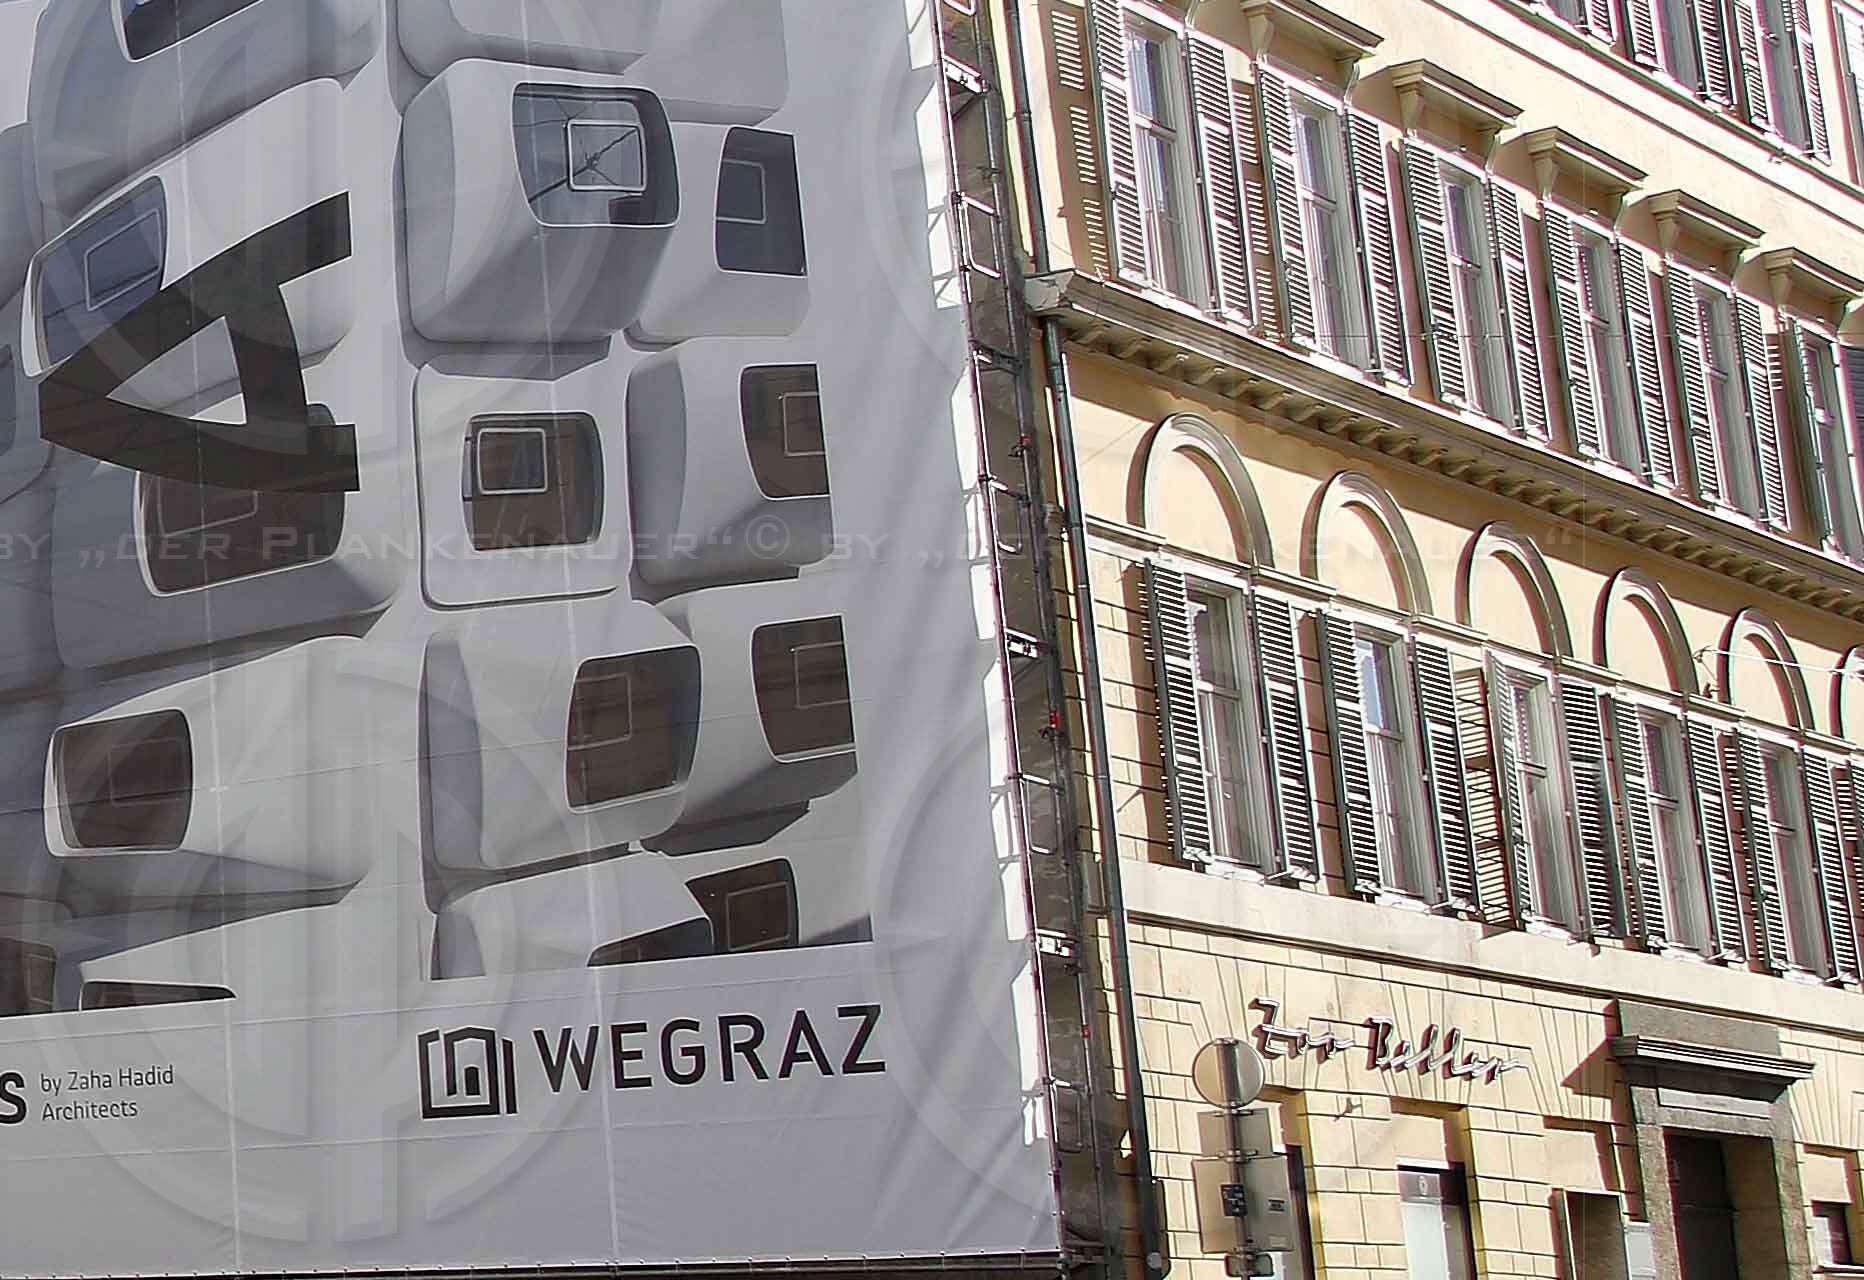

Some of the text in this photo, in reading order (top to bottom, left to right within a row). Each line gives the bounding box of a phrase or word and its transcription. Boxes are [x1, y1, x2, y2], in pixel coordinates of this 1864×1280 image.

[532, 1004, 887, 1094] WEGRAZ
[40, 1064, 174, 1096] by Zaha Hadid
[41, 1099, 138, 1121] Architects
